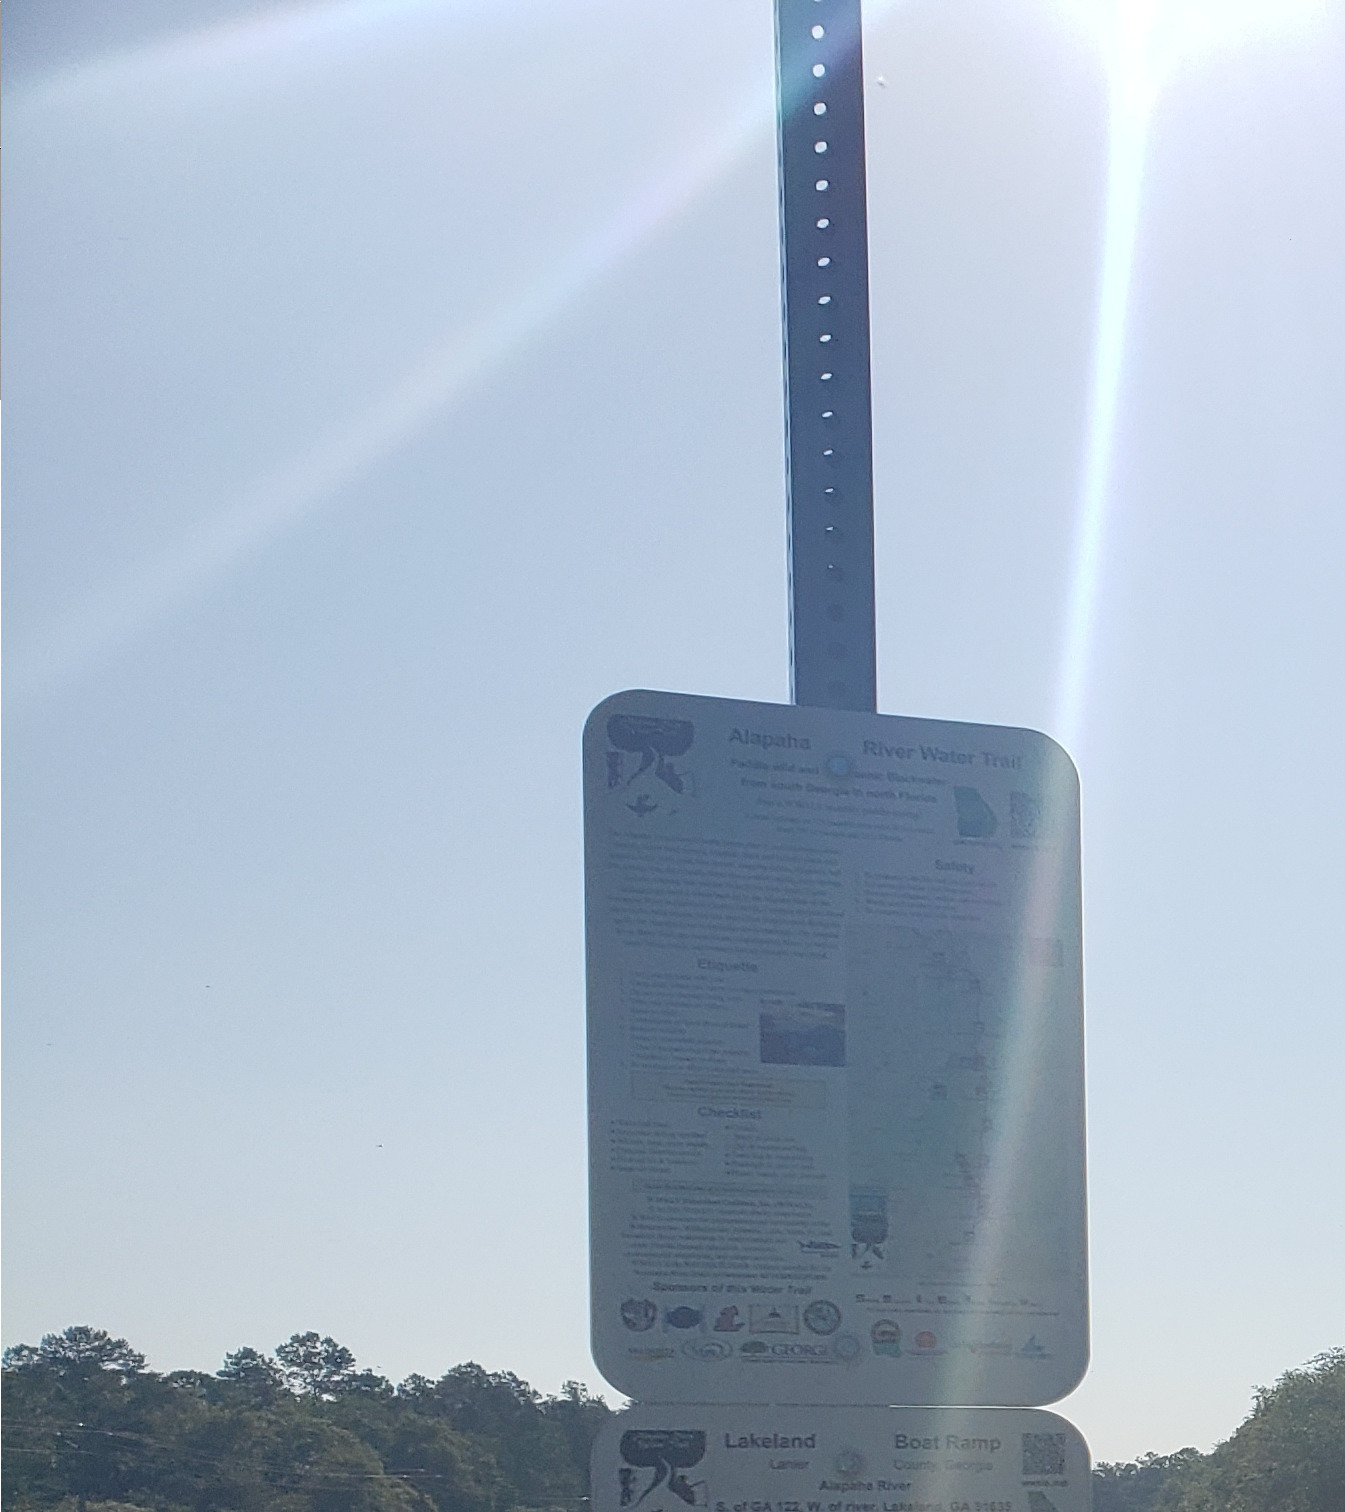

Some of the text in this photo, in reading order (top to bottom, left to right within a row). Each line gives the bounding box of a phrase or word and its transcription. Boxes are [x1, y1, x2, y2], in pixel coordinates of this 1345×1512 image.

[728, 728, 1022, 769] Alapaha River Water Trail
[935, 859, 975, 874] Safety
[697, 958, 758, 972] Etiquette
[698, 1106, 762, 1120] Checklist
[772, 1343, 834, 1356] GEORGI
[725, 1433, 1002, 1452] Lakeland Boat Ramp
[770, 1459, 809, 1469] Lanier
[819, 1480, 912, 1493] Alapaha River
[733, 1501, 747, 1512] of
[750, 1502, 772, 1512] GA
[827, 1501, 842, 1512] of
[949, 1502, 971, 1512] GA
